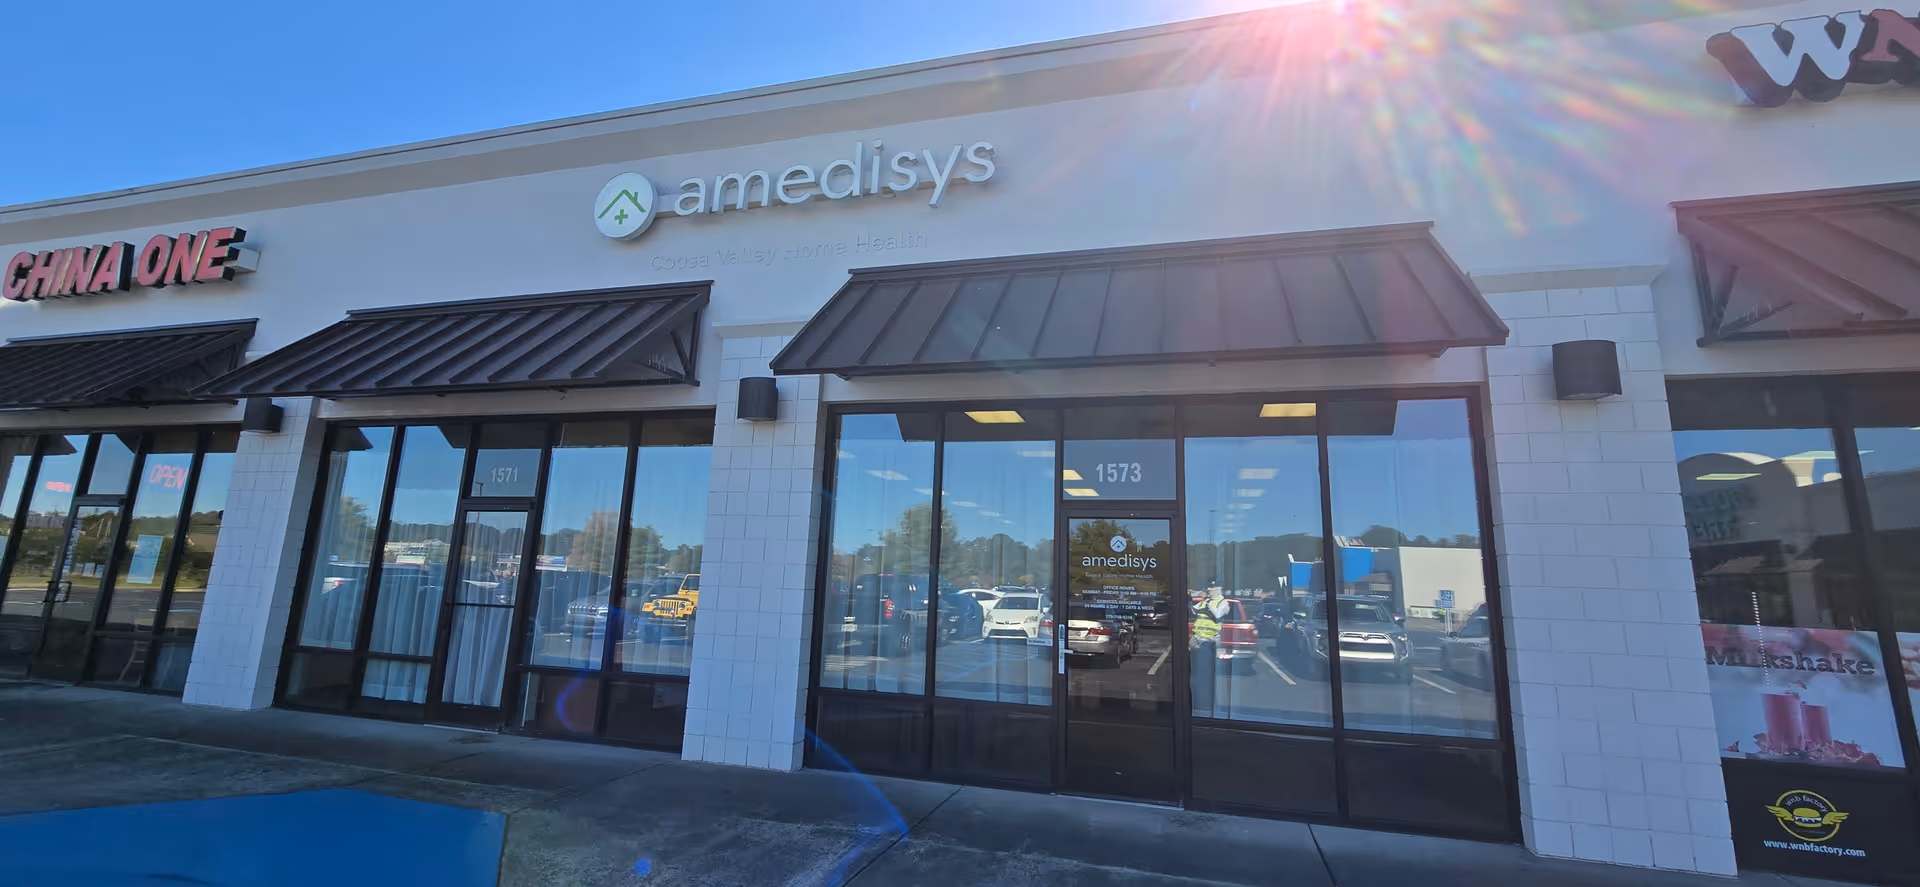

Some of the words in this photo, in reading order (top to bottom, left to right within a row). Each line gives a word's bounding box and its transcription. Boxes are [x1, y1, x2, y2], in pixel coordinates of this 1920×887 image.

[673, 139, 996, 217] amedisys
[651, 252, 709, 271] Coosa
[855, 230, 928, 252] Health
[2, 241, 129, 300] CHINA
[137, 226, 241, 286] ONE
[149, 463, 189, 490] OPEN
[491, 466, 519, 483] 1571
[1095, 462, 1142, 483] 1573
[1082, 553, 1157, 571] amedisys
[1785, 795, 1801, 806] wnb
[1802, 795, 1828, 812] factory
[1763, 840, 1866, 857] www.wnbfactory.com
